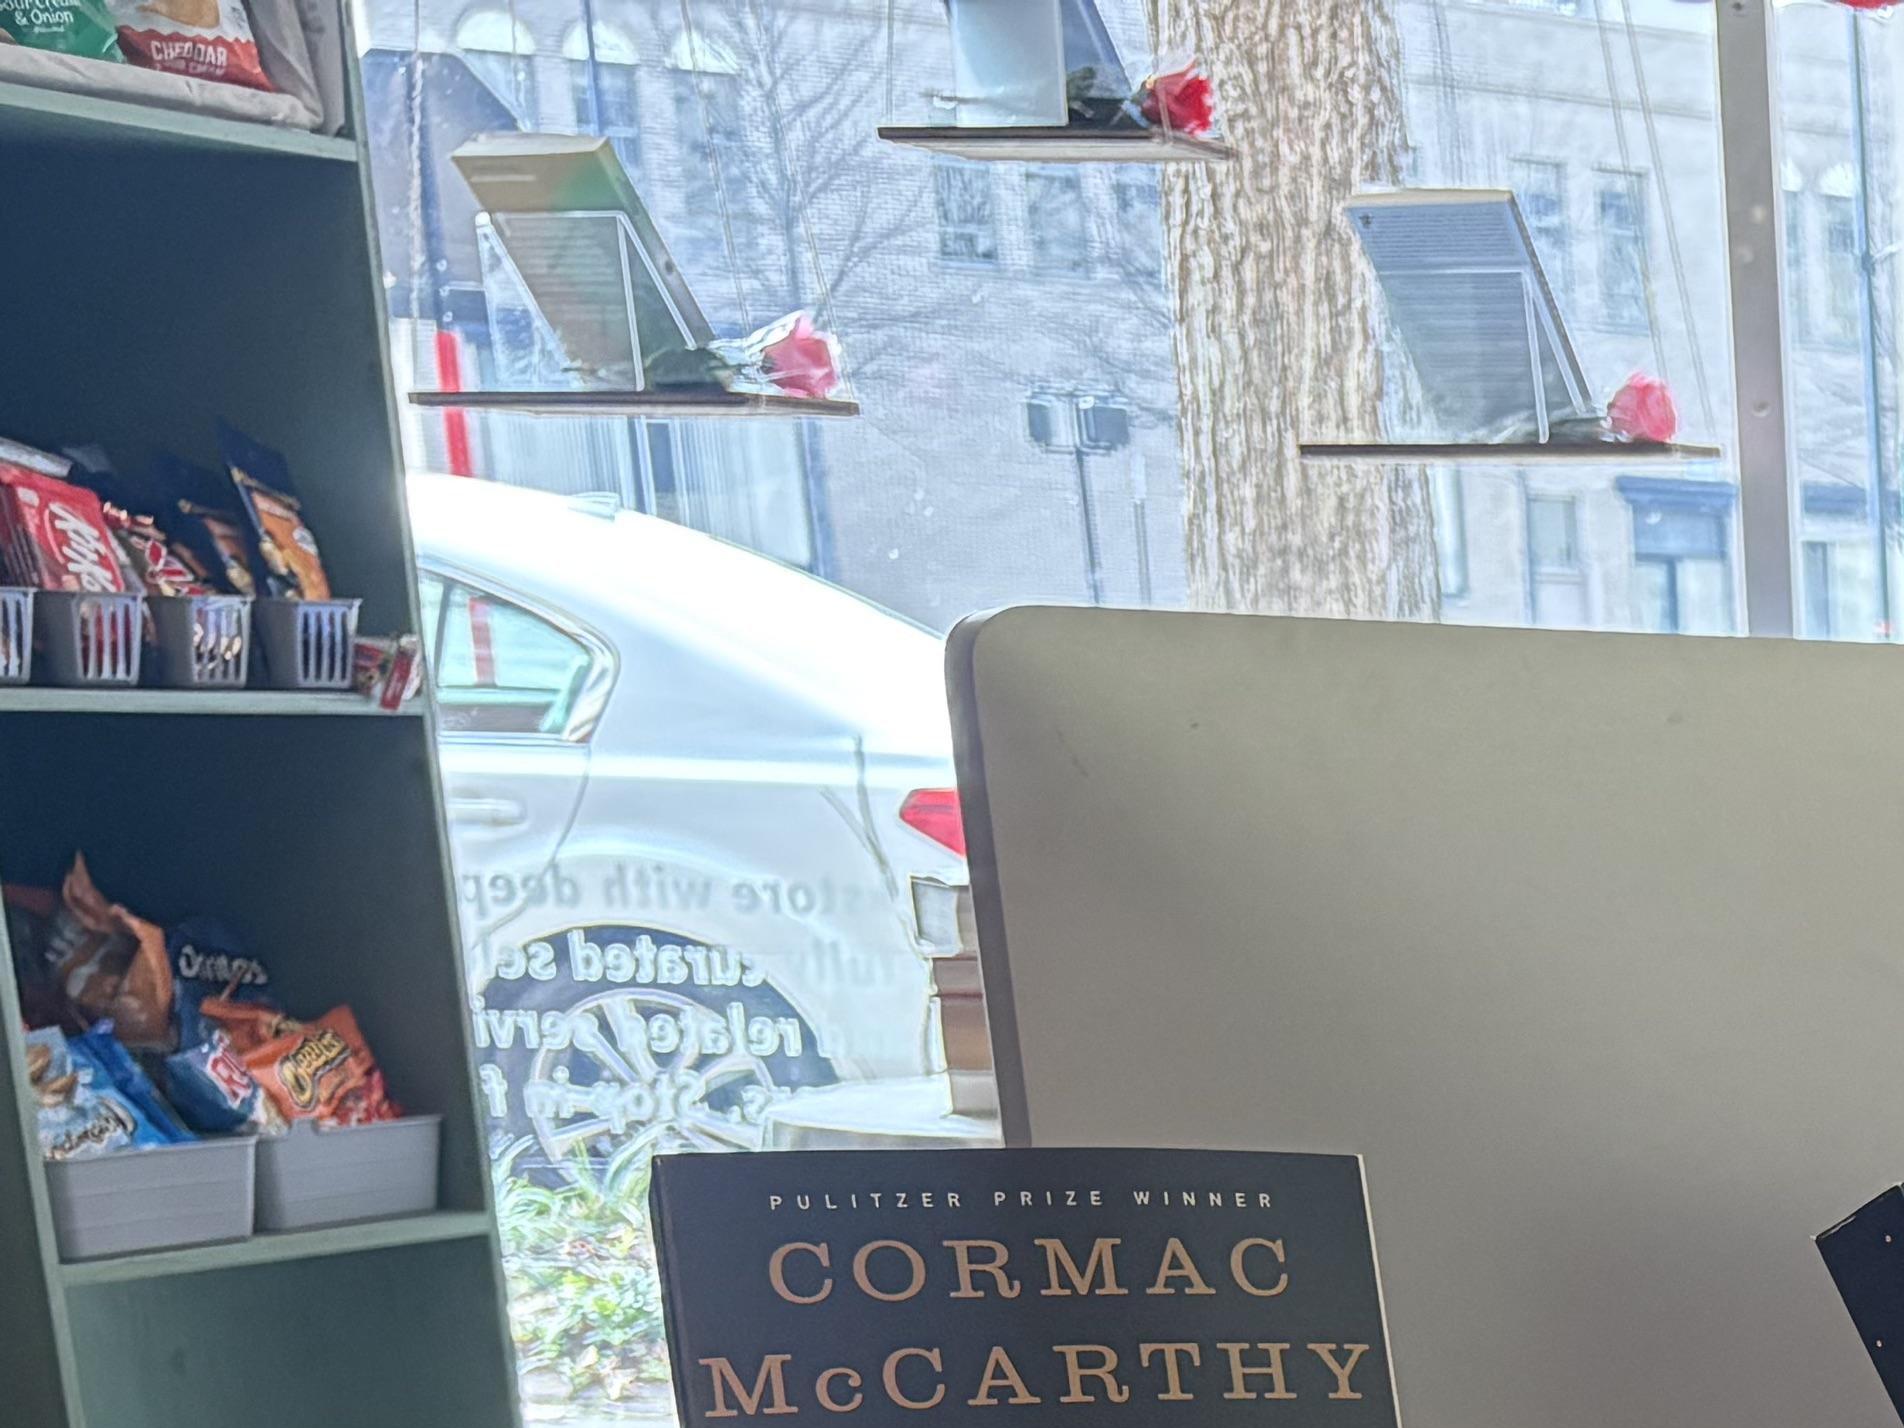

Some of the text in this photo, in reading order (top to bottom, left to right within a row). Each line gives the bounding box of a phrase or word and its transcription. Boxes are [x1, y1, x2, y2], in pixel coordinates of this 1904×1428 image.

[31, 5, 74, 26] Onion
[151, 40, 228, 67] CHEDDAR
[179, 944, 268, 985] Doritos
[768, 1188, 1275, 1211] PULITZER PRIZE WINNER
[767, 1236, 1292, 1305] CORMAC
[697, 1341, 1371, 1419] McCARTHY
